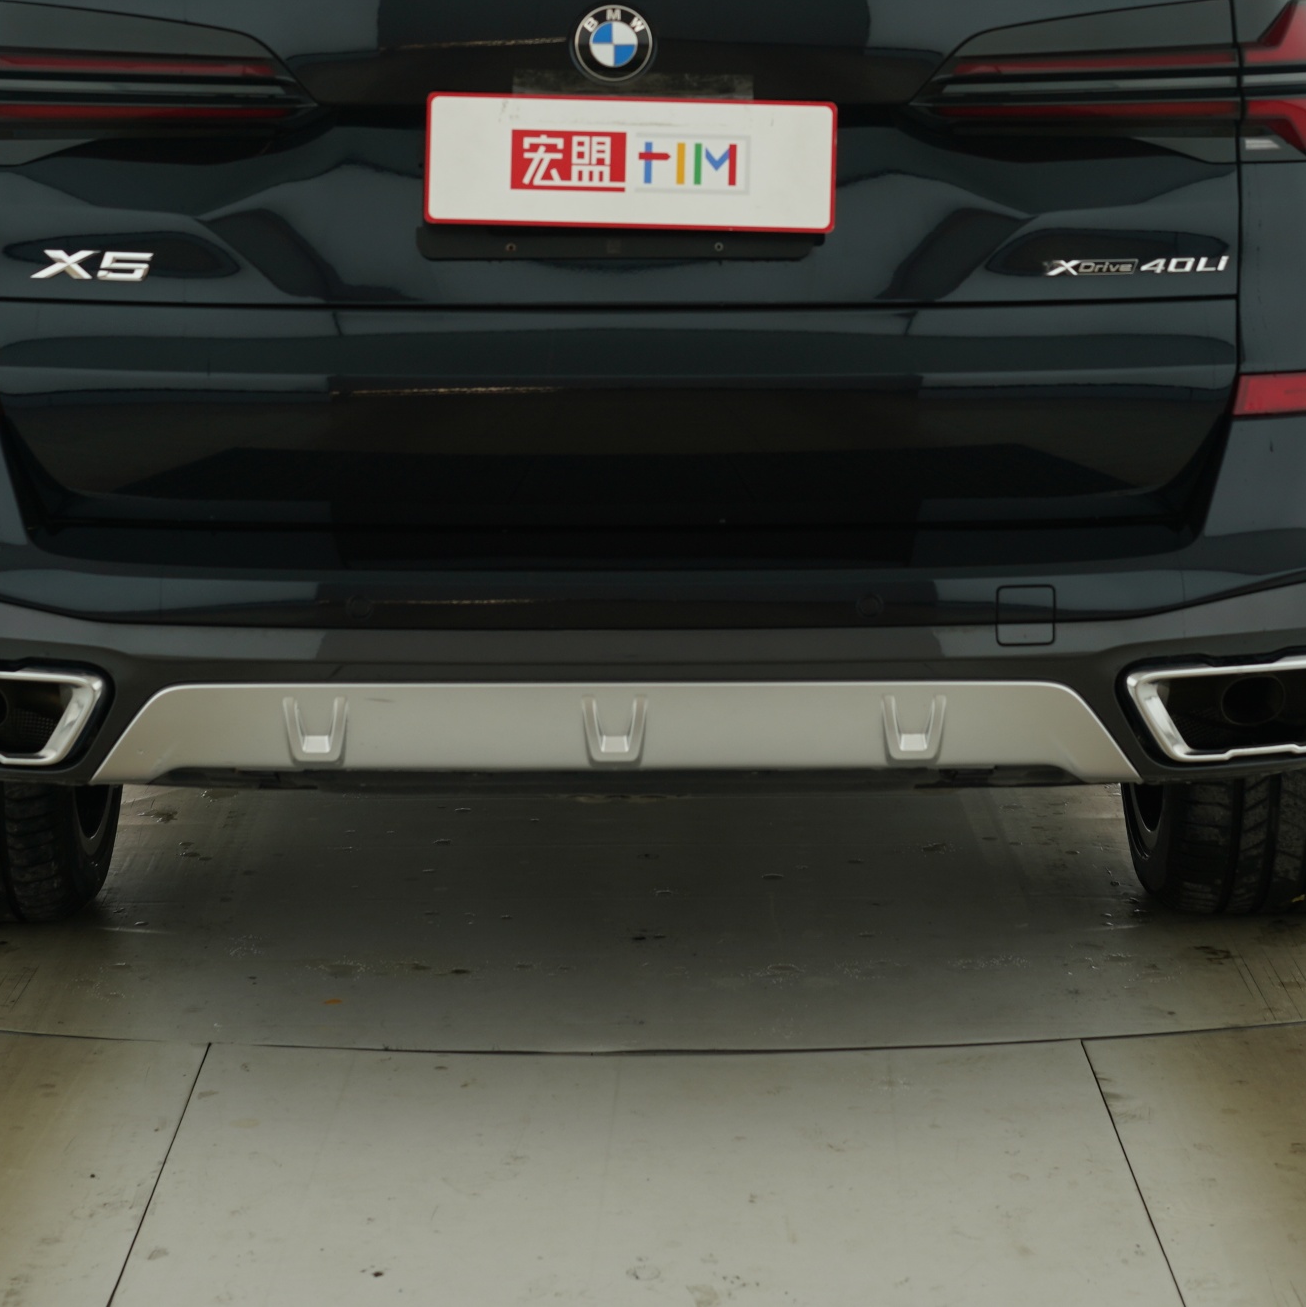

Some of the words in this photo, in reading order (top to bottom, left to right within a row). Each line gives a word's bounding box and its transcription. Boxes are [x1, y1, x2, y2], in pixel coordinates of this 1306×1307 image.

[583, 8, 645, 32] BMW
[522, 134, 624, 188] 宏盟
[30, 249, 154, 281] X5
